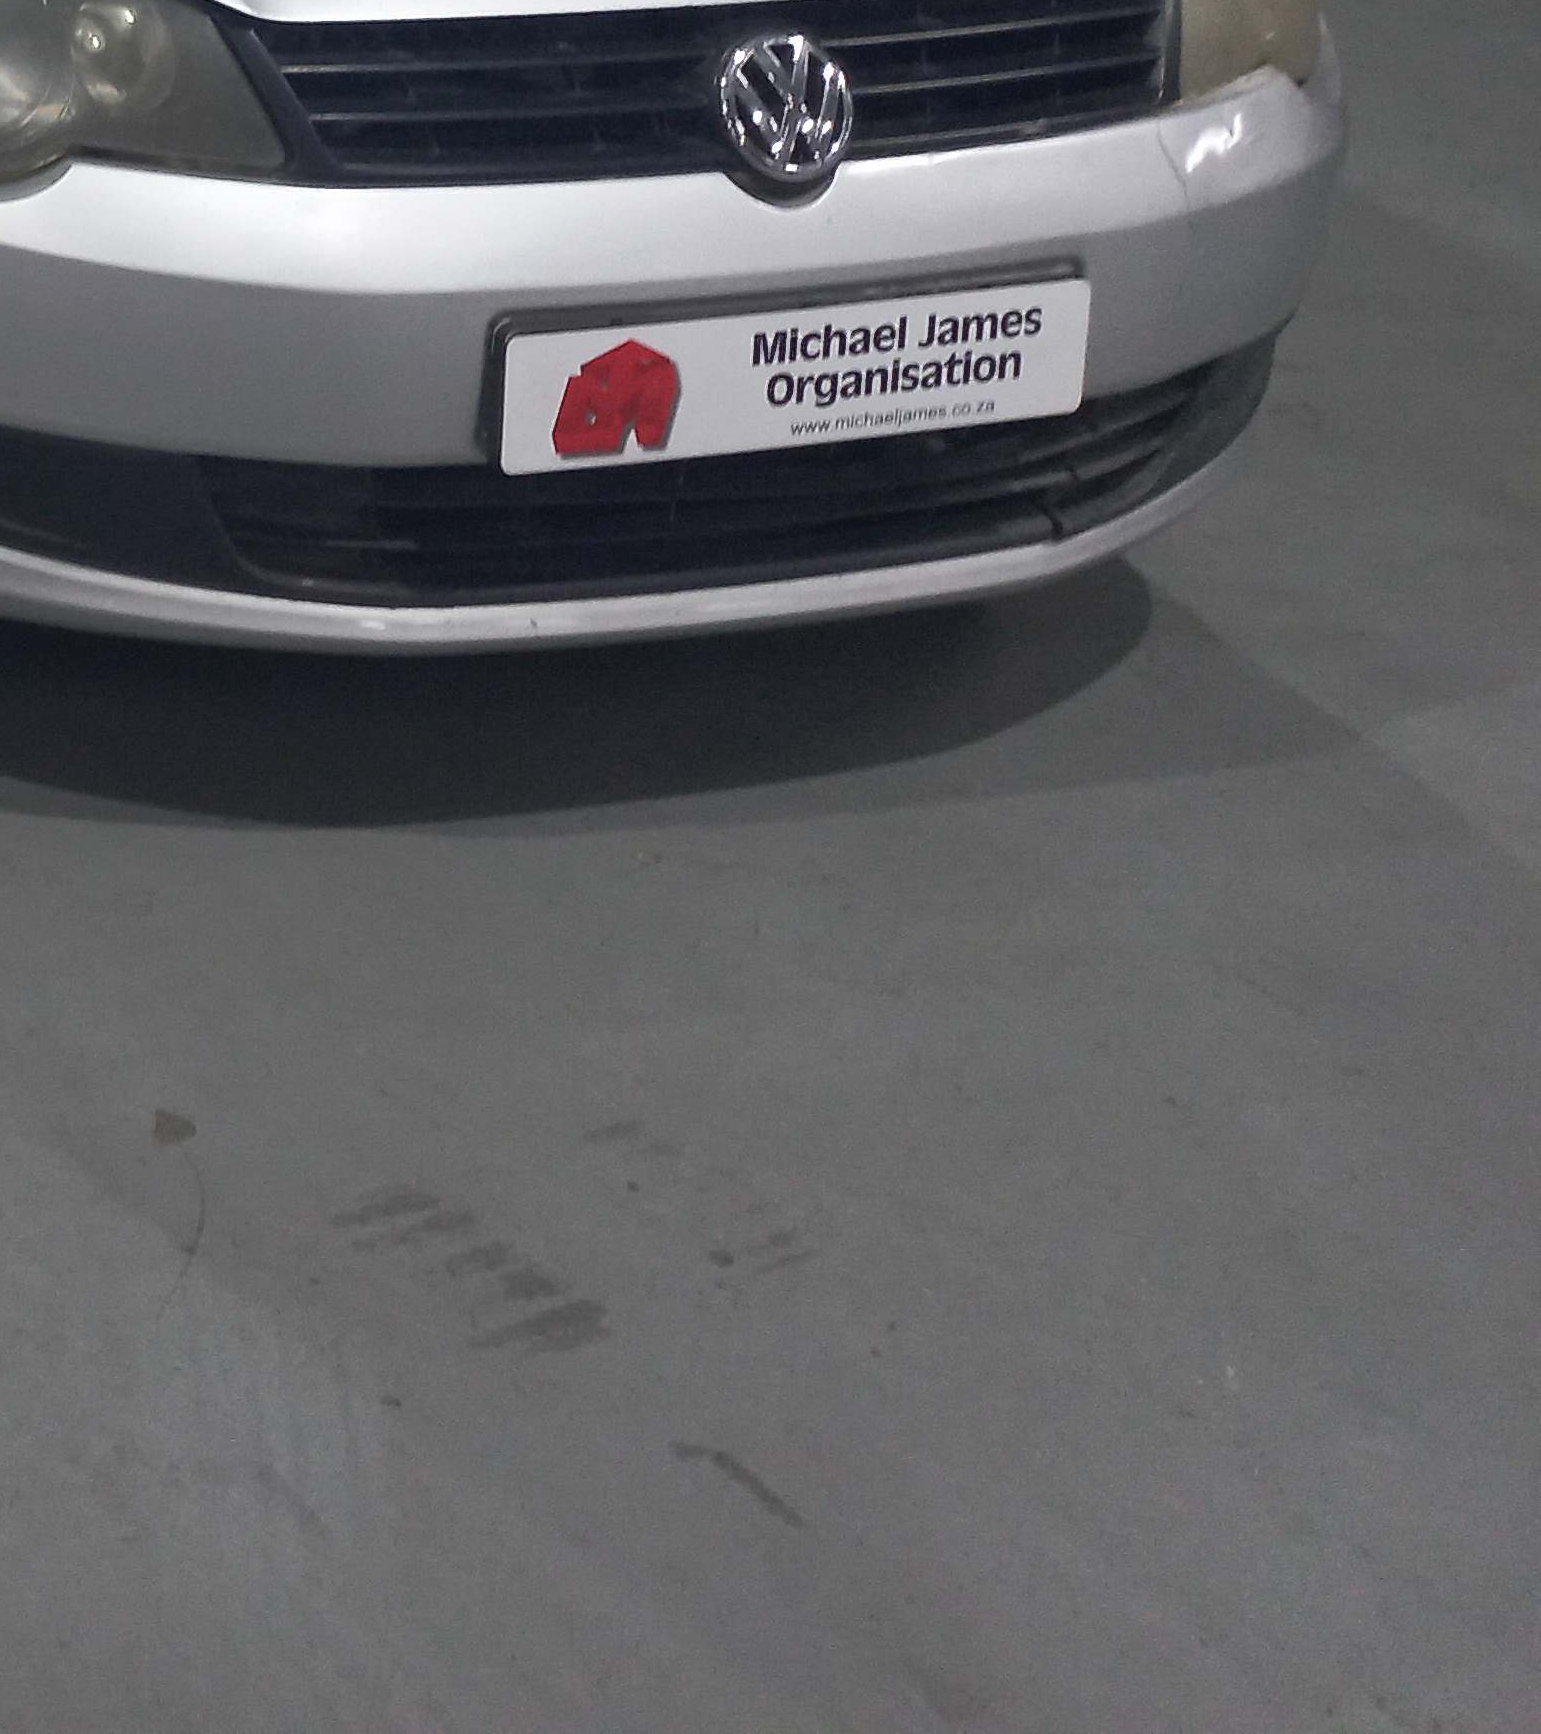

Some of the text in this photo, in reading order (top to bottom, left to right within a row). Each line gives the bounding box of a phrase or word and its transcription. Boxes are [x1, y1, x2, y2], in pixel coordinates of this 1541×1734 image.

[751, 305, 1043, 367] Michael James
[767, 350, 1020, 408] Organisation
